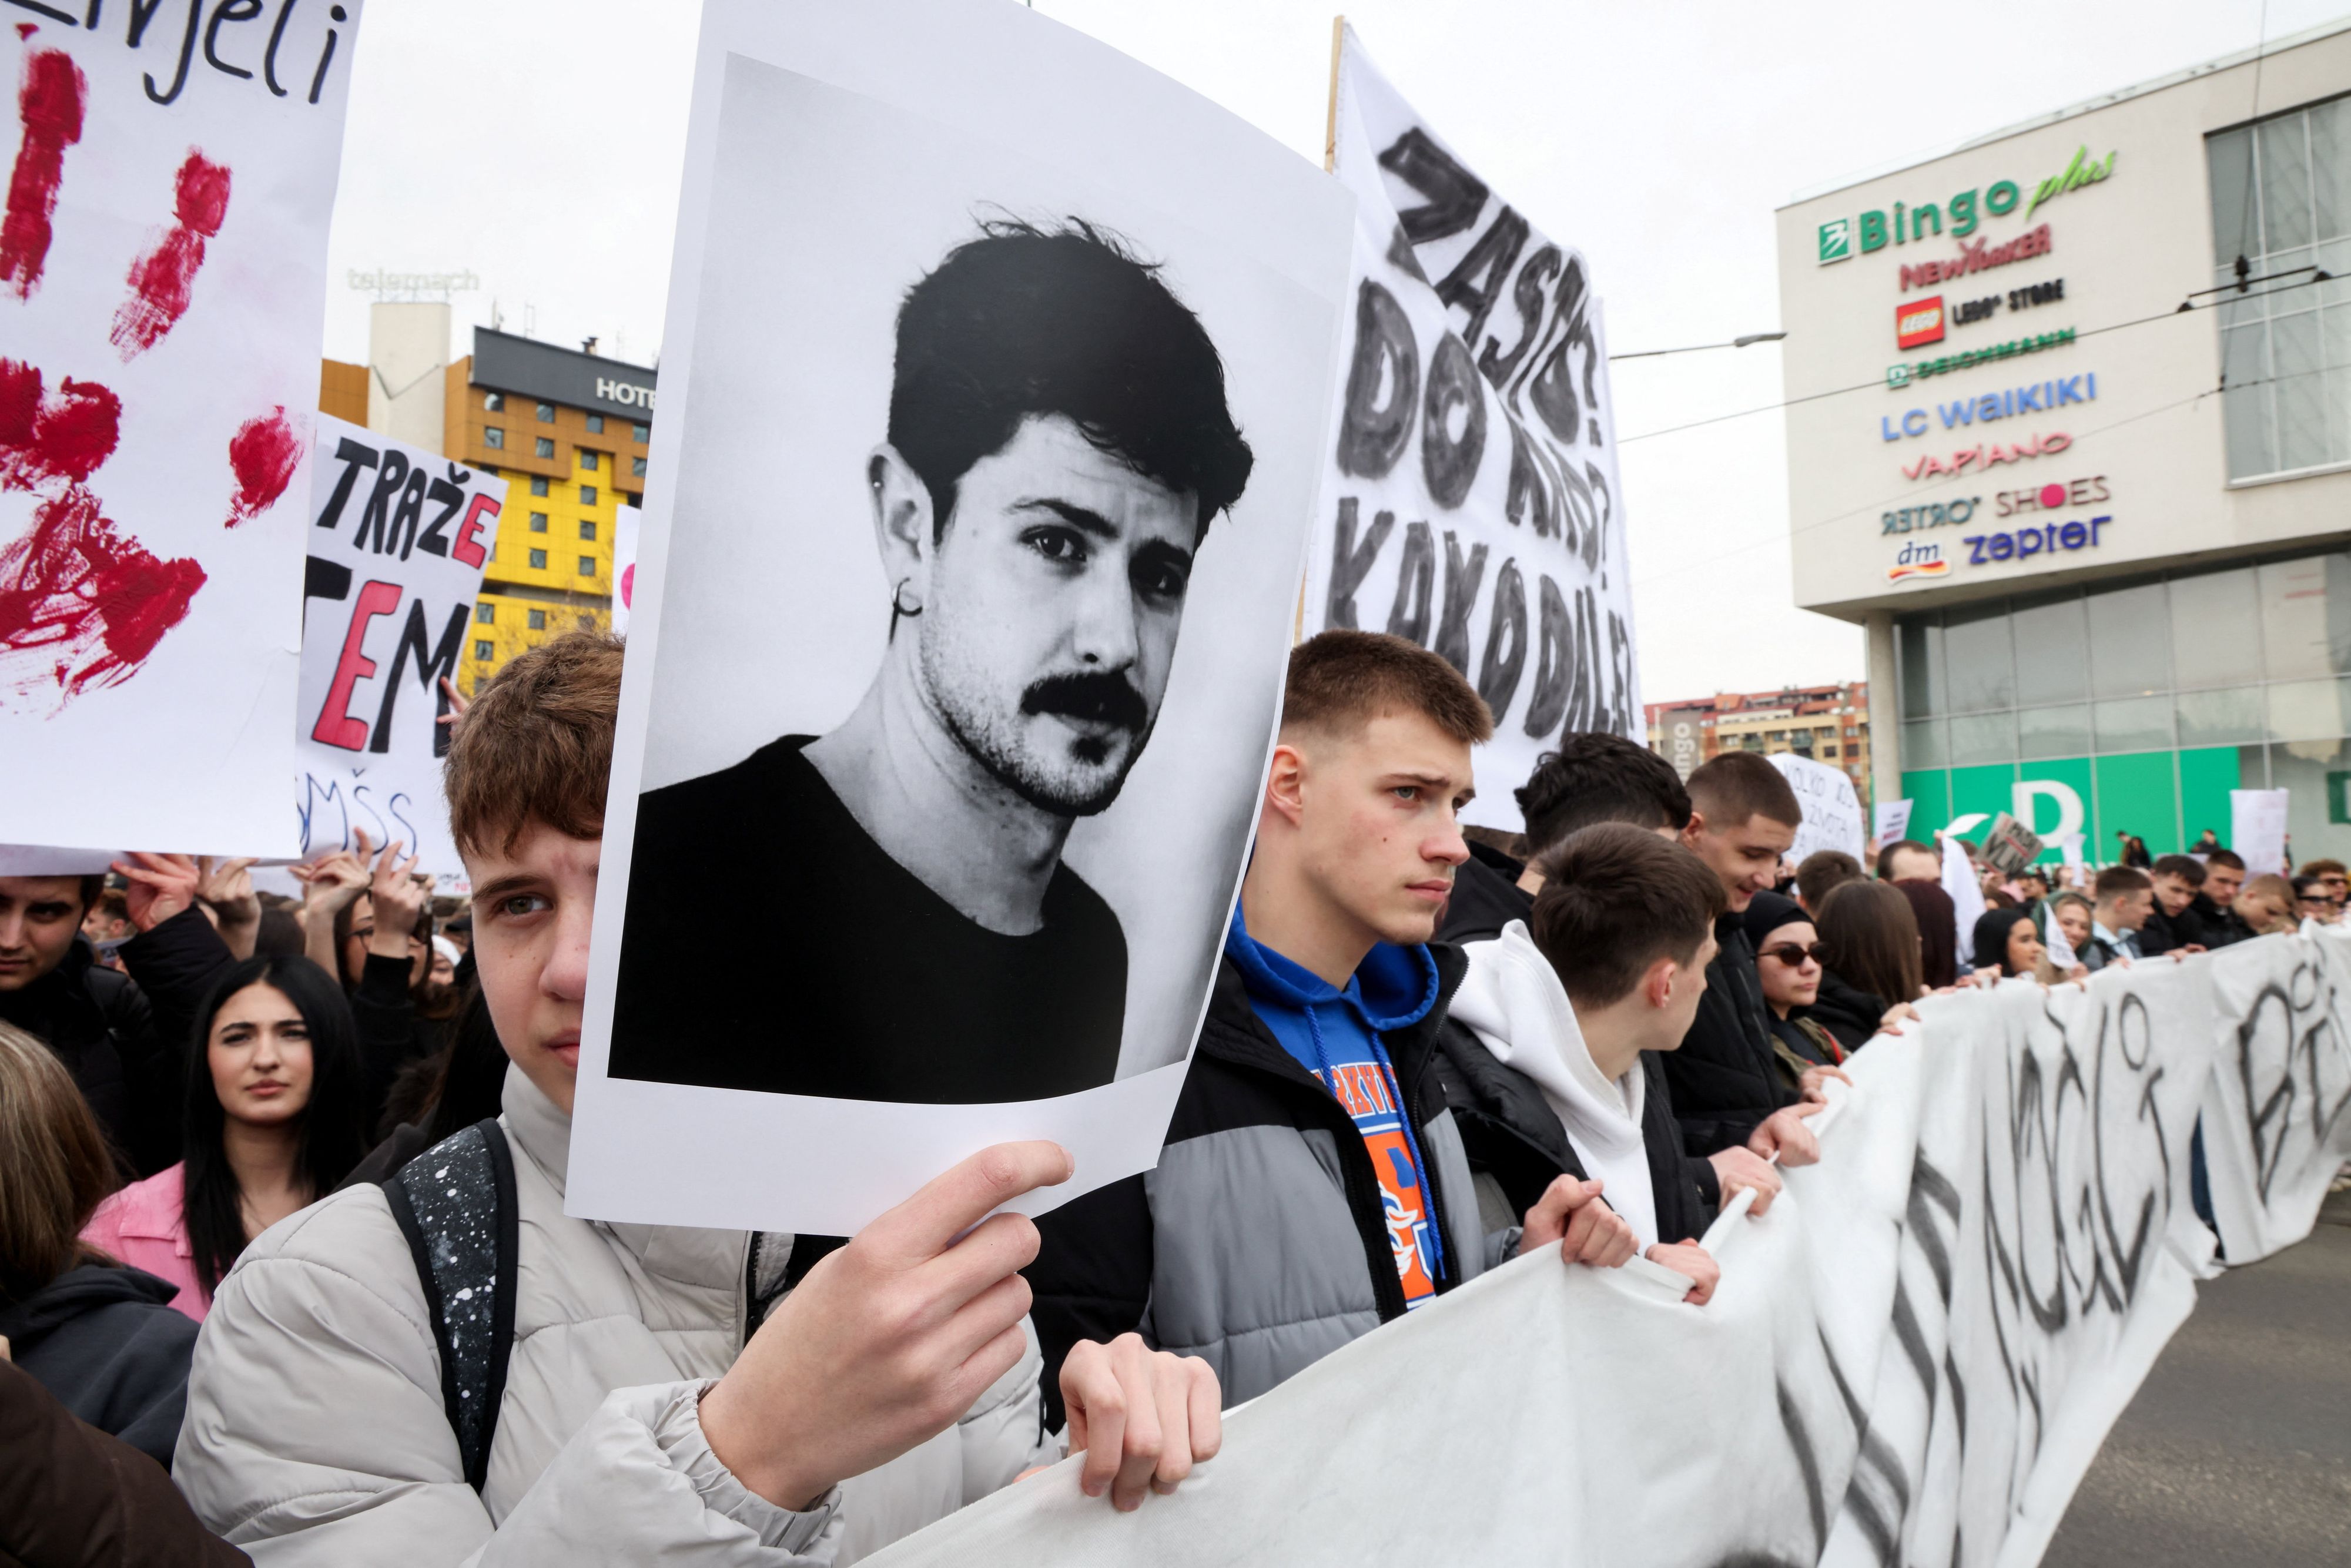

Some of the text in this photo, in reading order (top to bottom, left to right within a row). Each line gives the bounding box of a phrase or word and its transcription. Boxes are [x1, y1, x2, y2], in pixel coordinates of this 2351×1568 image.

[1860, 145, 2117, 254] Bingo plus
[348, 268, 480, 291] telemach
[2009, 279, 2065, 312] STORE
[1917, 327, 2076, 378] DEICHMANN
[1881, 408, 1929, 442] LC
[317, 437, 501, 569] TRAŽE
[1897, 516, 2112, 567] dm zepter
[1673, 722, 1697, 786] ingo
[297, 768, 417, 860] MŠS
